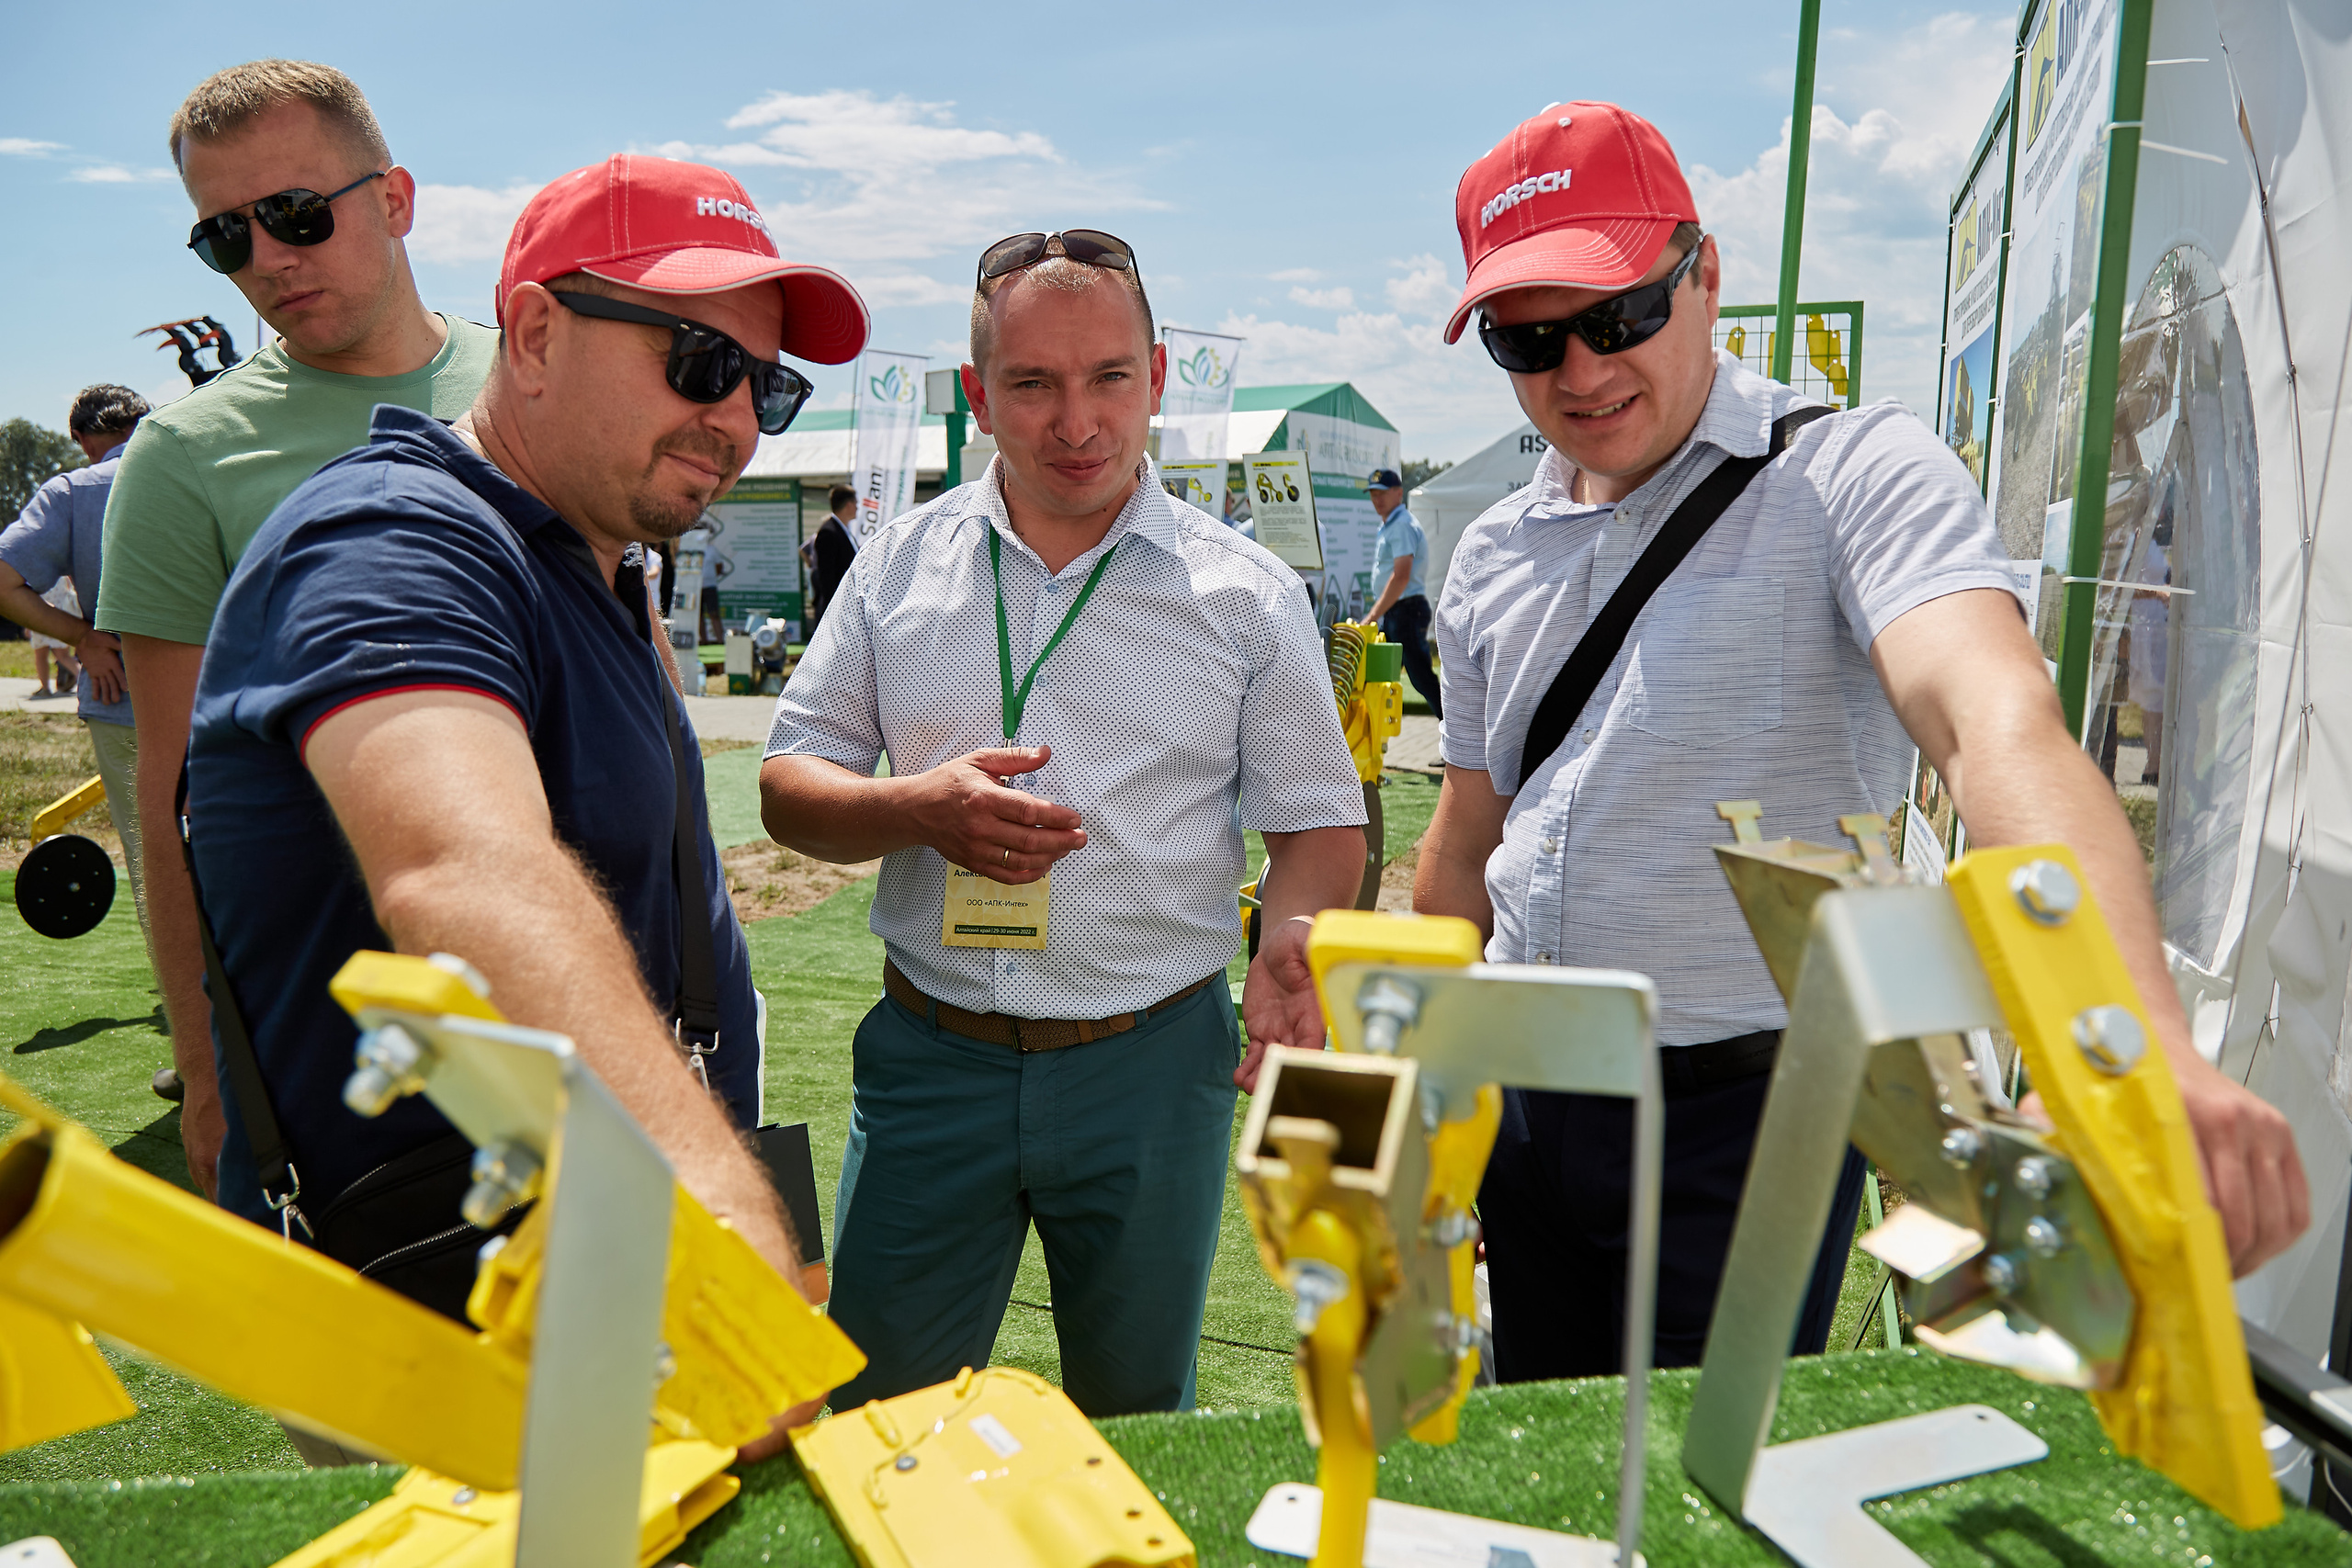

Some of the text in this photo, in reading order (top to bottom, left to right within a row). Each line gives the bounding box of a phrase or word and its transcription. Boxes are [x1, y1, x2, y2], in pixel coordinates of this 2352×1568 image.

[696, 197, 775, 246] HORS
[1481, 169, 1572, 229] HORSCH
[1520, 434, 1549, 453] AS
